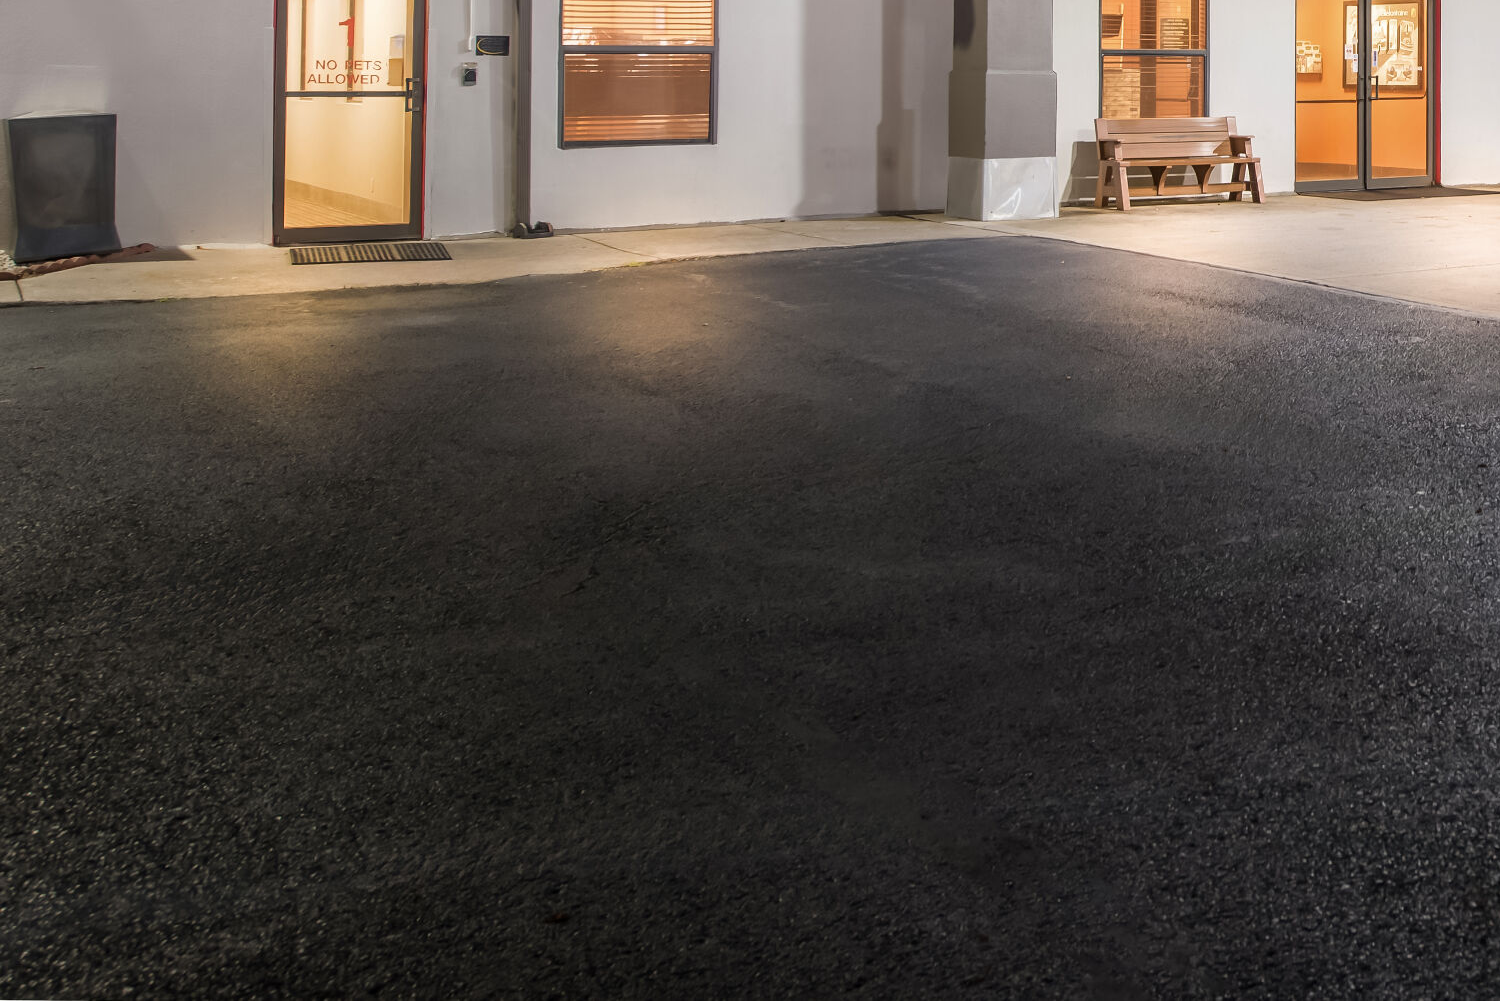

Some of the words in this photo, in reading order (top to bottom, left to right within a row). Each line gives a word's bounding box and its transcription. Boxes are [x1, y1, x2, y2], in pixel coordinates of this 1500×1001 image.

[338, 15, 355, 47] 1
[315, 59, 338, 71] NO
[345, 59, 382, 71] PETS
[307, 73, 380, 85] ALLOWED
